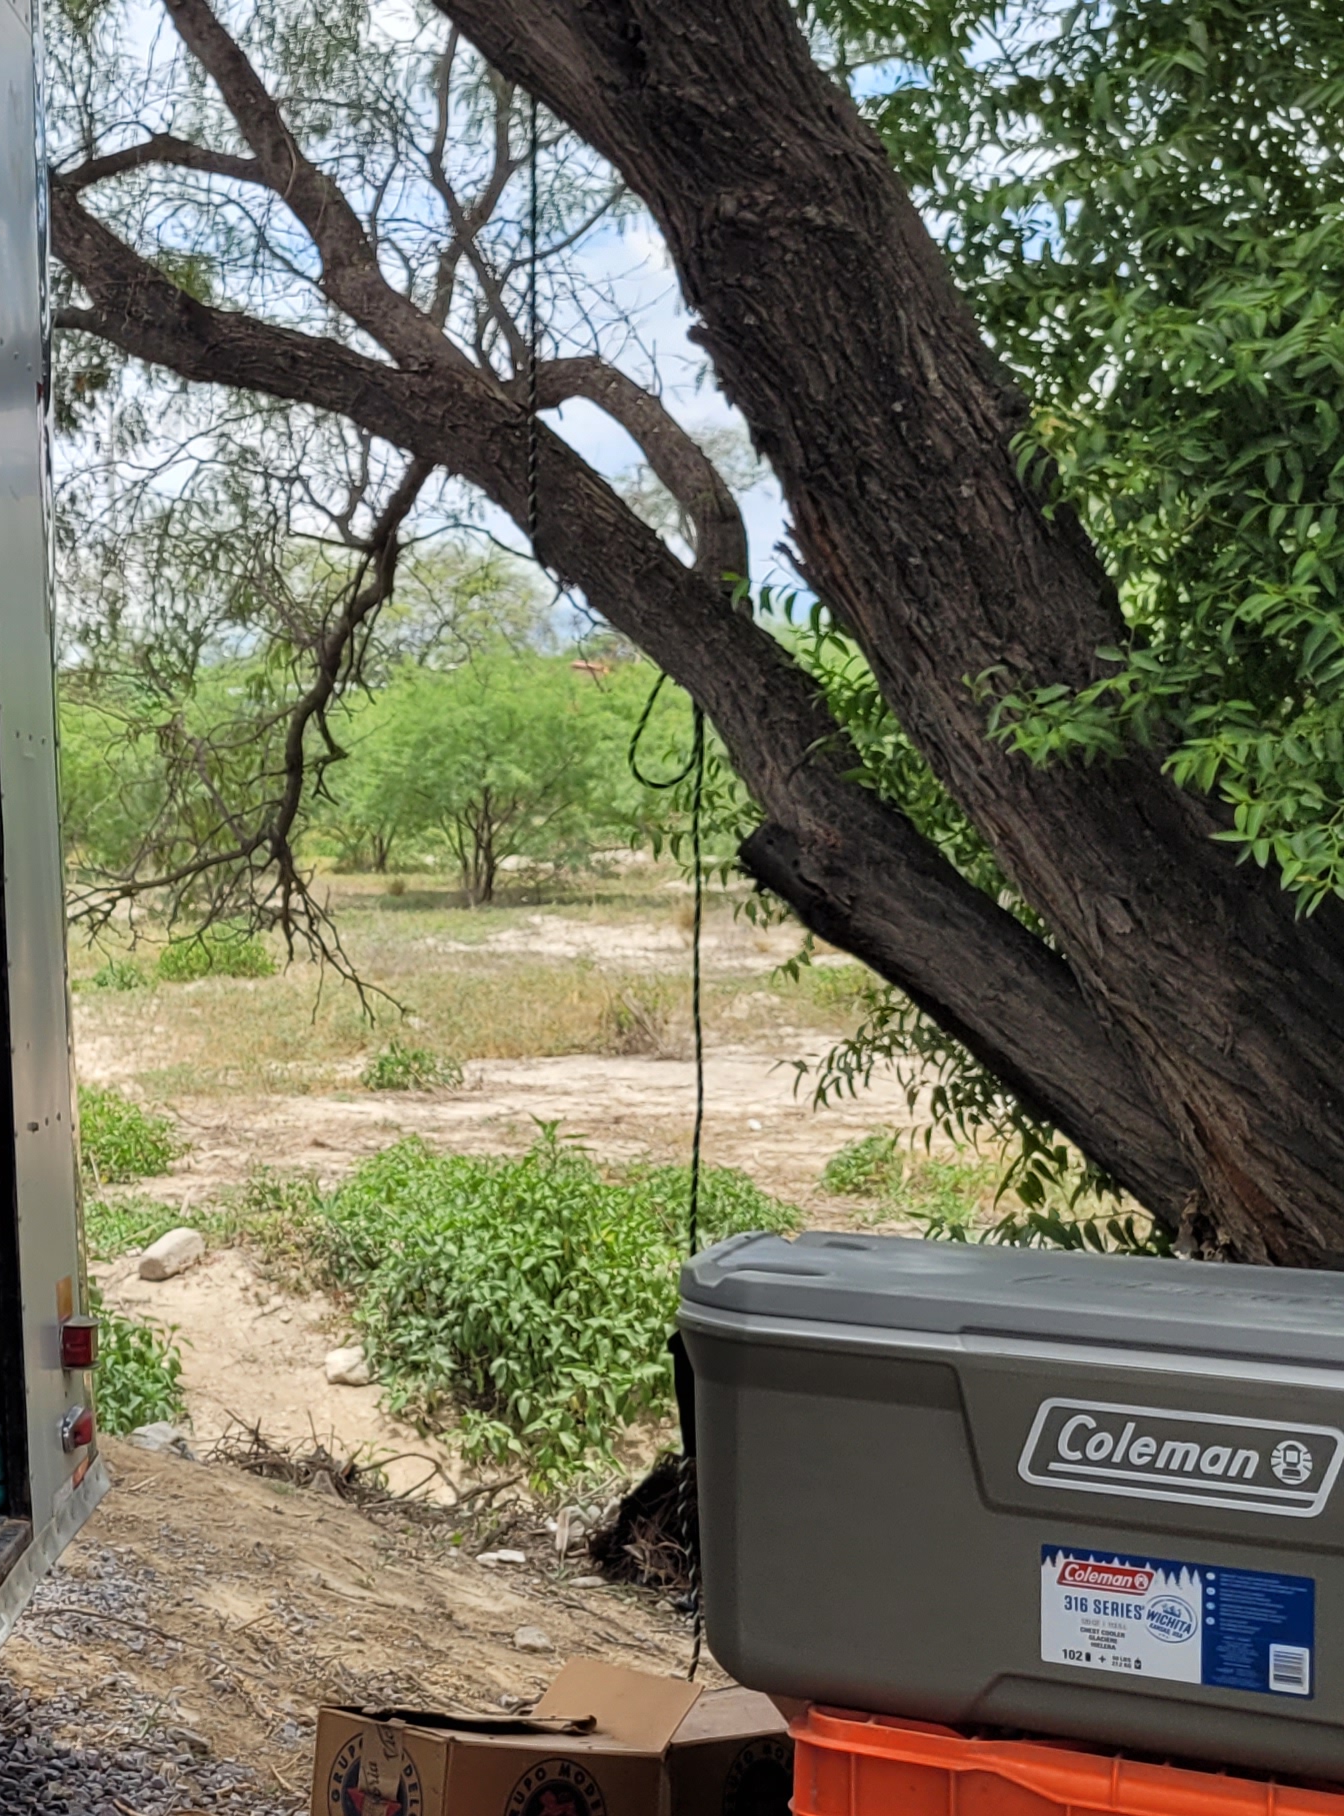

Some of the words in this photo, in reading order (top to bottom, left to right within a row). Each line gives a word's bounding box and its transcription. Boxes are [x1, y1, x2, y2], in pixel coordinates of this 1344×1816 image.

[1056, 1414, 1260, 1480] Coleman
[1064, 1564, 1133, 1588] Coleman
[1064, 1595, 1088, 1613] 316
[1093, 1599, 1142, 1621] SERIES
[1146, 1608, 1192, 1635] WICHITA
[1062, 1649, 1083, 1662] 102
